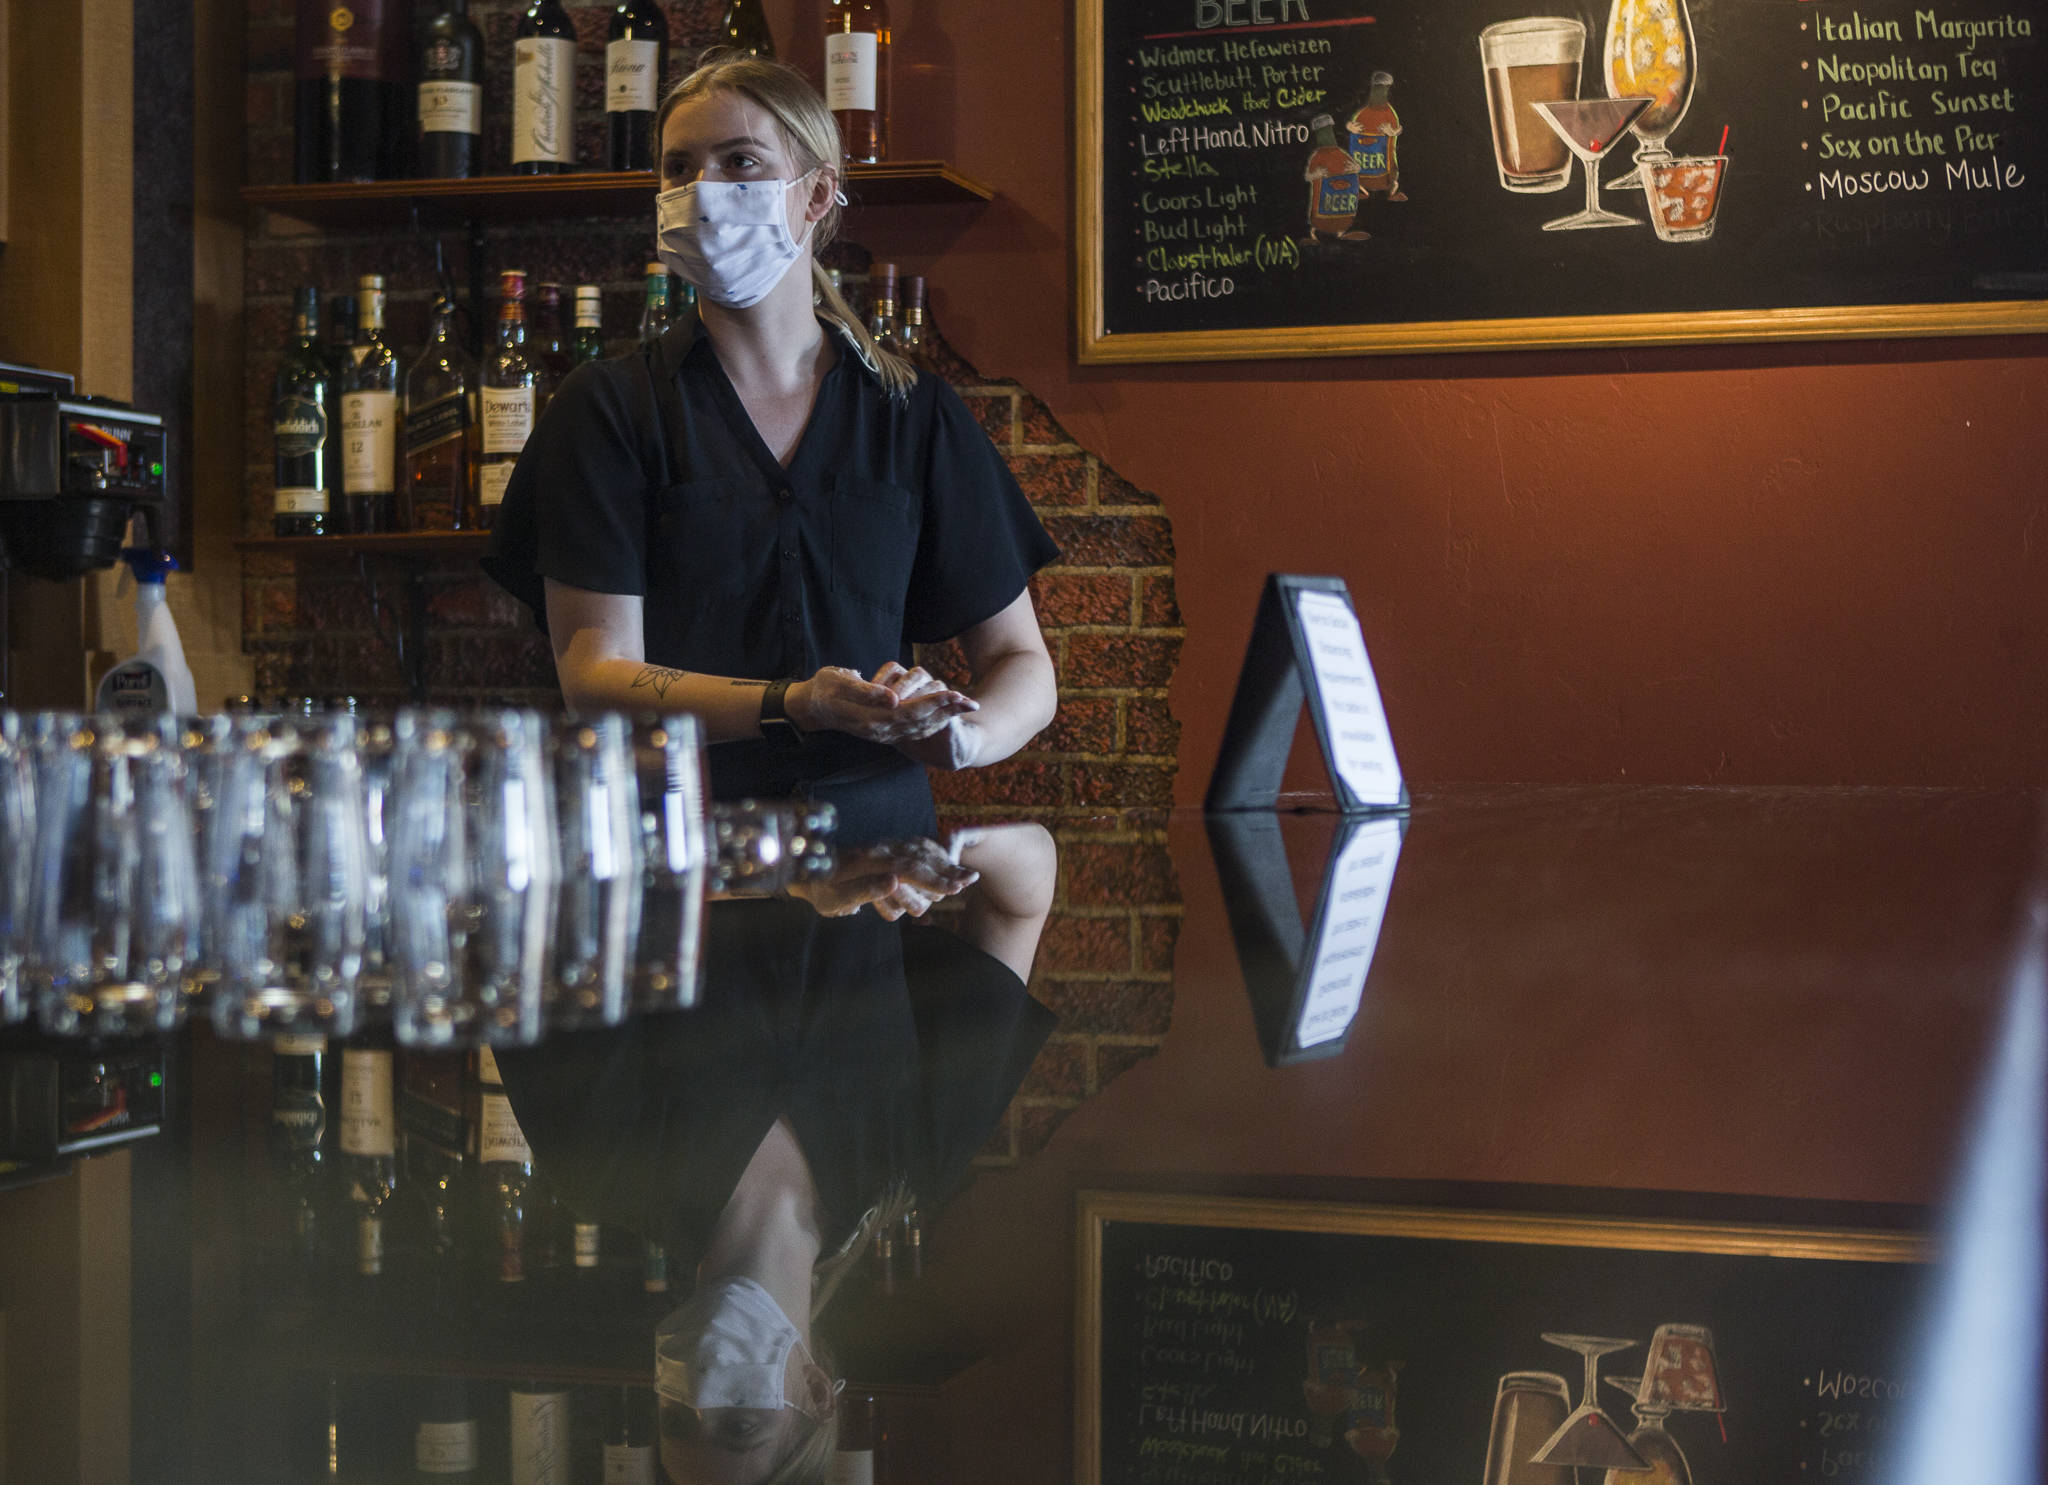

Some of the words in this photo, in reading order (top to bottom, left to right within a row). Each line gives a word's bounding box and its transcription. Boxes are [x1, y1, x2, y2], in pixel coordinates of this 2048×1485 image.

[1816, 9, 1903, 42] Italian
[1914, 8, 2031, 50] Margarita
[1223, 39, 1332, 62] Hefeweizen
[1262, 63, 1326, 89] Porter
[1817, 53, 1948, 87] Neopolitan
[1141, 95, 1233, 123] Woodchuck
[1276, 86, 1327, 109] Cider
[1822, 90, 1913, 122] Pacific
[1931, 88, 2015, 115] Sunset
[1140, 126, 1191, 158] Left
[1194, 121, 1248, 151] Hand
[1251, 120, 1310, 148] Nitro
[1819, 131, 1862, 160] Sex
[1867, 135, 1900, 156] on
[1903, 130, 1947, 156] the
[1954, 124, 2001, 153] Pier
[1143, 154, 1221, 182] Stella
[1353, 151, 1386, 169] BEER
[1819, 168, 1929, 200] Moscow
[1945, 155, 2025, 191] Mule
[1142, 191, 1202, 215] Coors
[1206, 184, 1258, 211] Light
[1144, 217, 1189, 243] Bud
[1193, 214, 1247, 243] Light
[1255, 233, 1300, 273] (NA)
[1146, 272, 1236, 303] Pacifico
